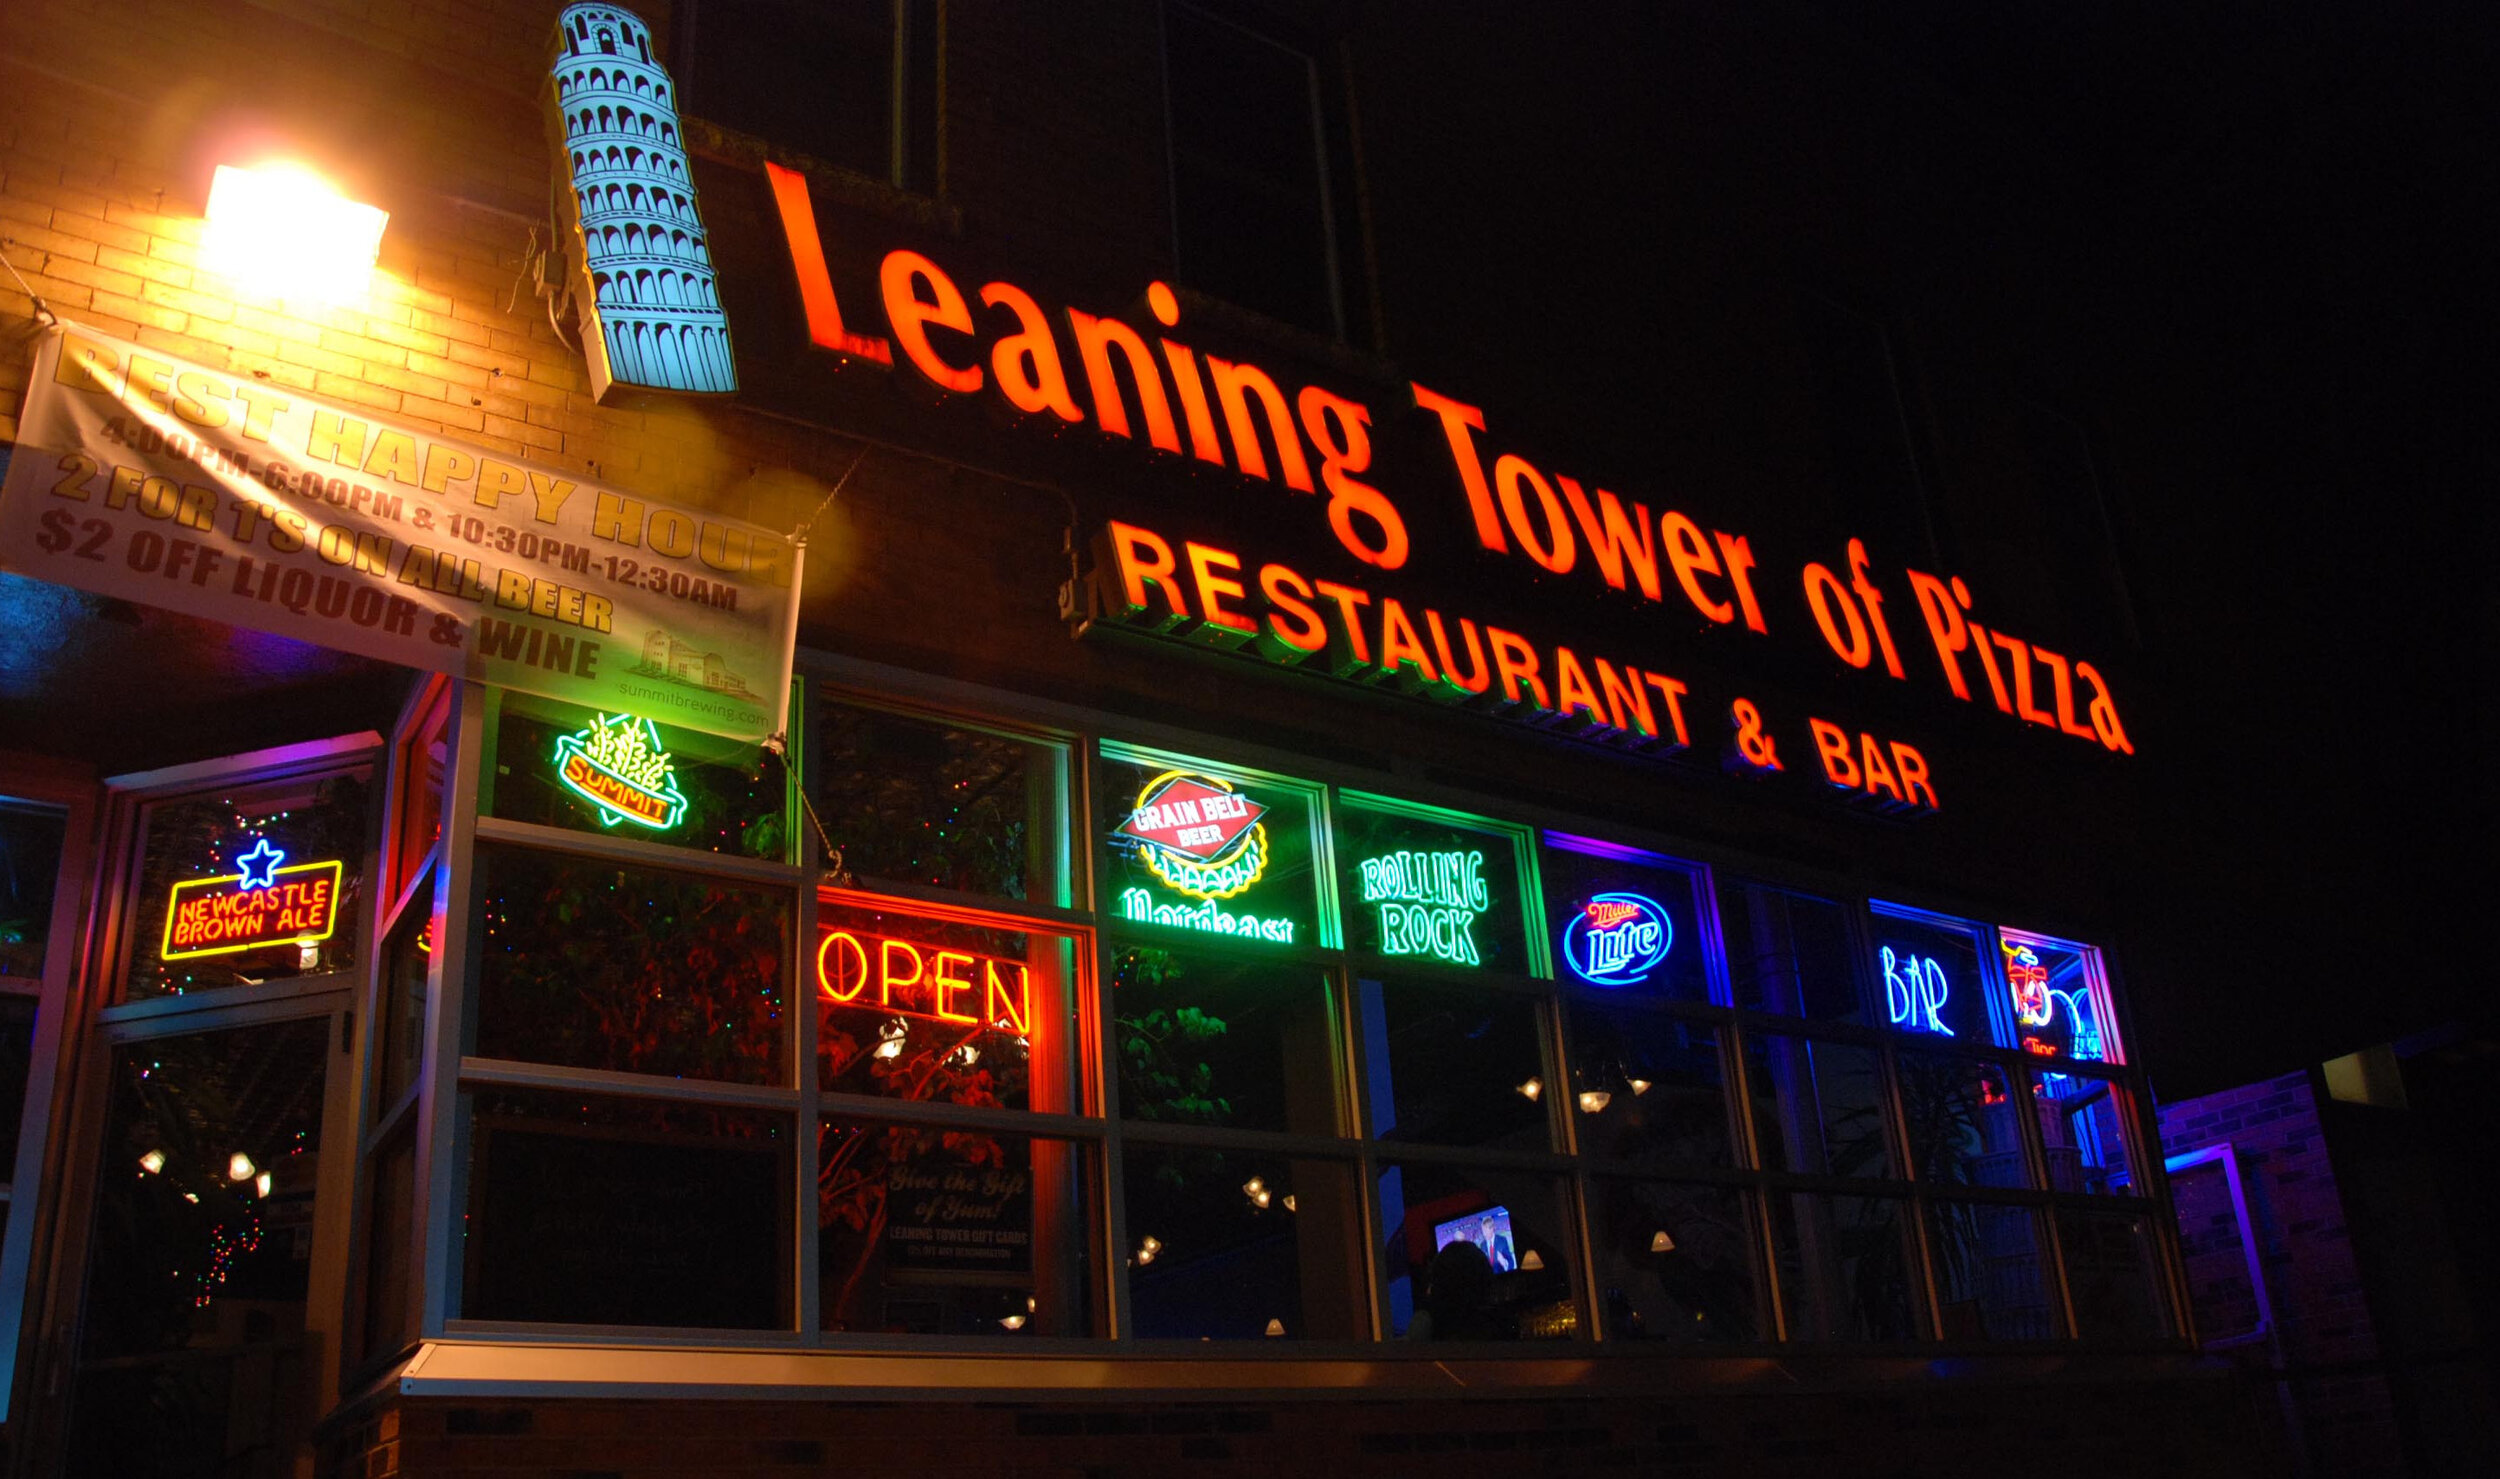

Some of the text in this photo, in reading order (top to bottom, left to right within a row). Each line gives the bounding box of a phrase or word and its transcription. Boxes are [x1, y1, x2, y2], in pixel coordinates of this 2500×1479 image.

[54, 332, 793, 588] BEST HAPPY HOUR
[765, 160, 2135, 755] Leaning Tower of Pizza
[51, 453, 614, 634] 2 FOR 1'S ON ALL BEER
[101, 415, 738, 613] 4:00PM-6:00PM & 10:30PM-12:30AM
[35, 507, 602, 680] $2 OFF LIQUOR & WINE
[1110, 519, 1940, 810] RESTAURANT & BAR
[618, 681, 770, 729] summitbrewing.com
[565, 754, 668, 819] SUMMIT
[1131, 793, 1249, 832] GRAIN BELT
[1176, 824, 1225, 849] BEER
[179, 879, 330, 924] NEWCASTLE
[1360, 850, 1489, 913] ROLLING
[173, 902, 325, 945] BROWN ALE
[1380, 903, 1481, 966] ROCK
[817, 931, 1031, 1035] OPEN
[1880, 945, 1955, 1037] BAR
[889, 1165, 1026, 1201] Give the Gift
[914, 1195, 945, 1224] of
[889, 1225, 934, 1241] LEANING
[935, 1227, 970, 1242] TOWER
[971, 1229, 993, 1244] GIFT
